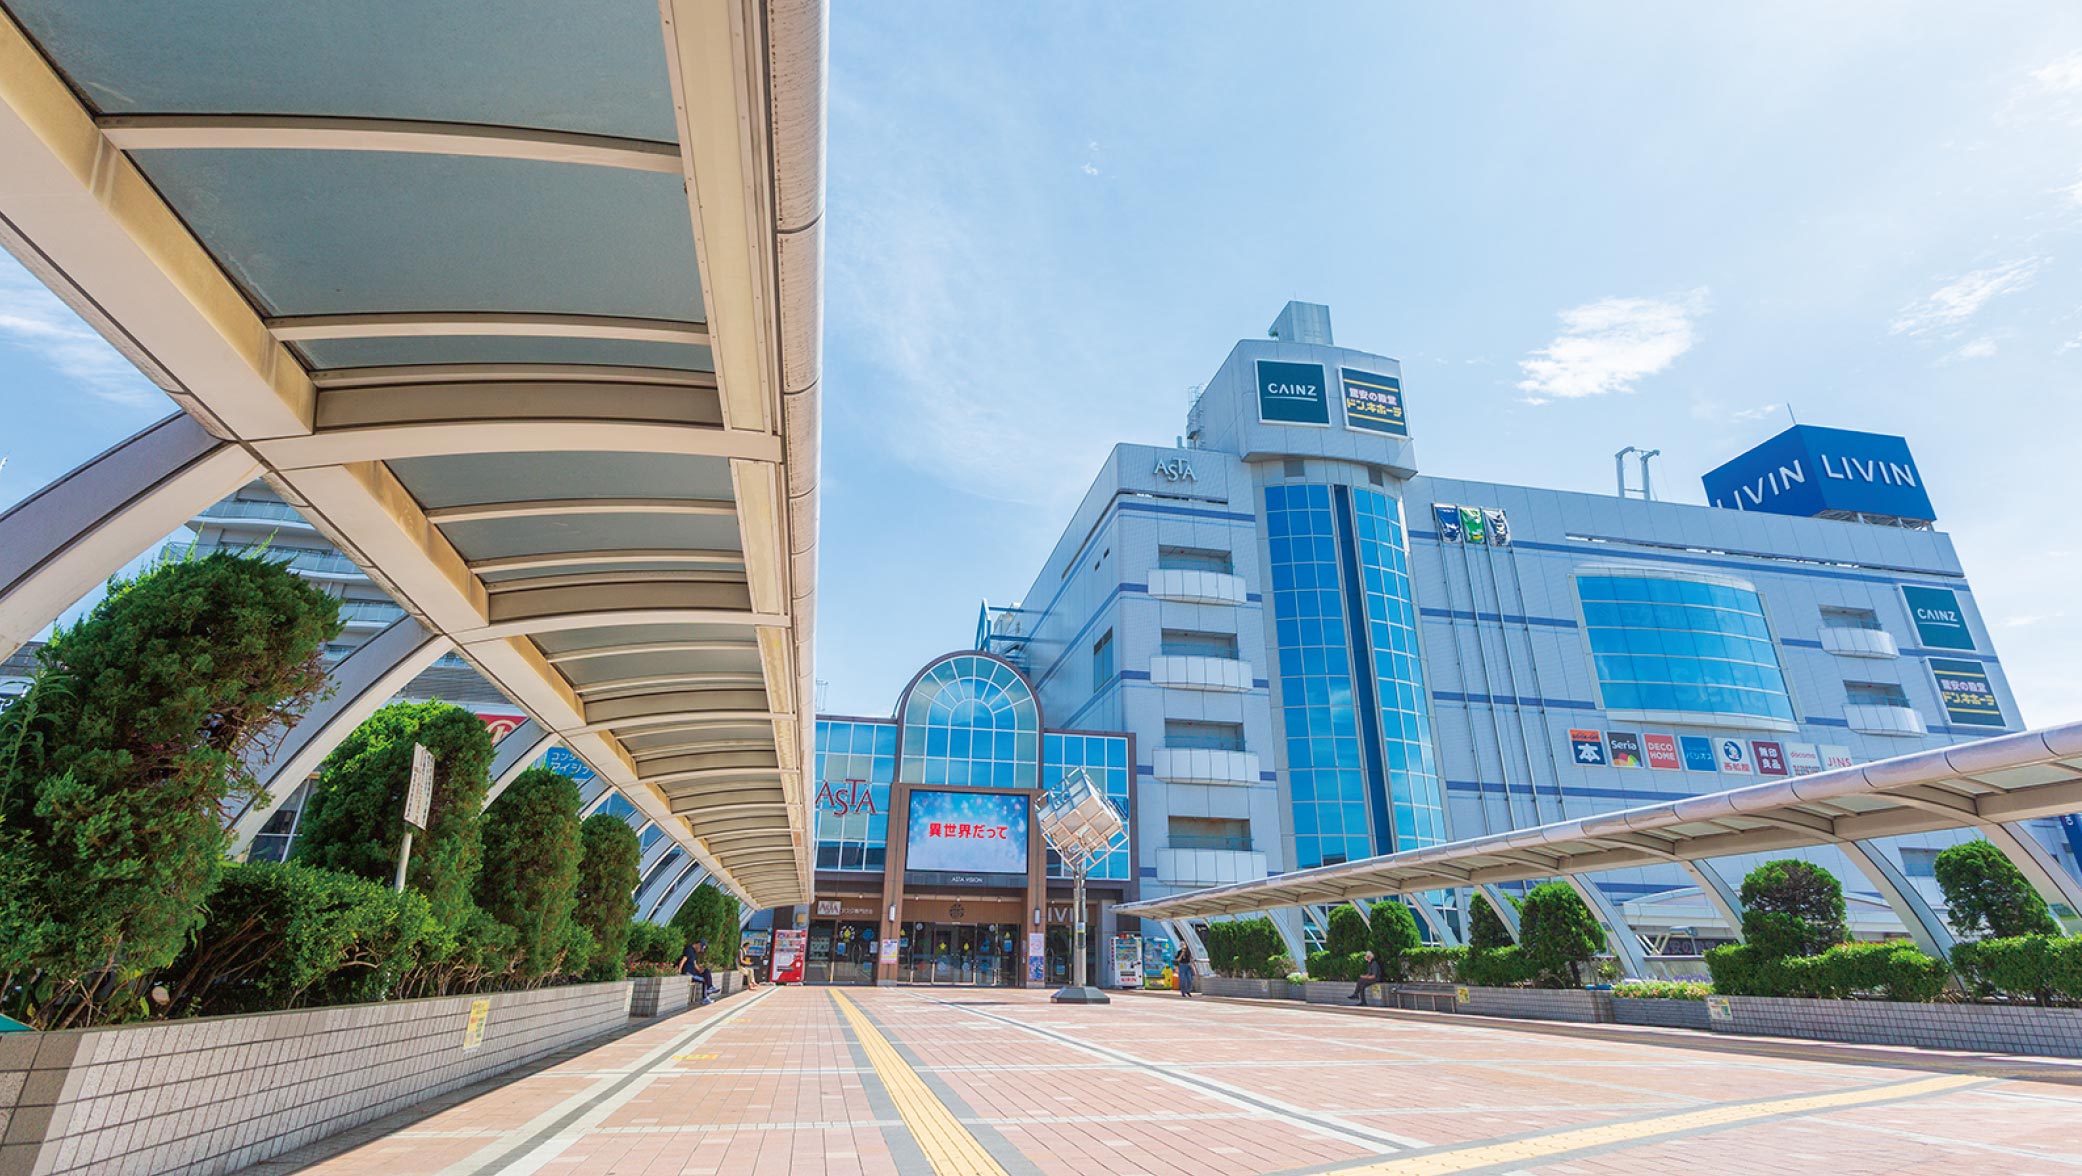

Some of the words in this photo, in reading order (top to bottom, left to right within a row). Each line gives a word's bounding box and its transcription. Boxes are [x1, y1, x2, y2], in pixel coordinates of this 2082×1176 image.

[1268, 383, 1317, 396] CAINZ
[1154, 457, 1197, 481] ASTA
[1821, 454, 1916, 487] LIVIN
[1917, 607, 1958, 622] CAINZ
[1610, 740, 1637, 750] Seria
[1648, 742, 1673, 751] DECO
[1650, 751, 1675, 761] HOME
[1827, 756, 1852, 768] JINS
[815, 779, 876, 816] ASTA
[929, 822, 1008, 840] 異世界だって
